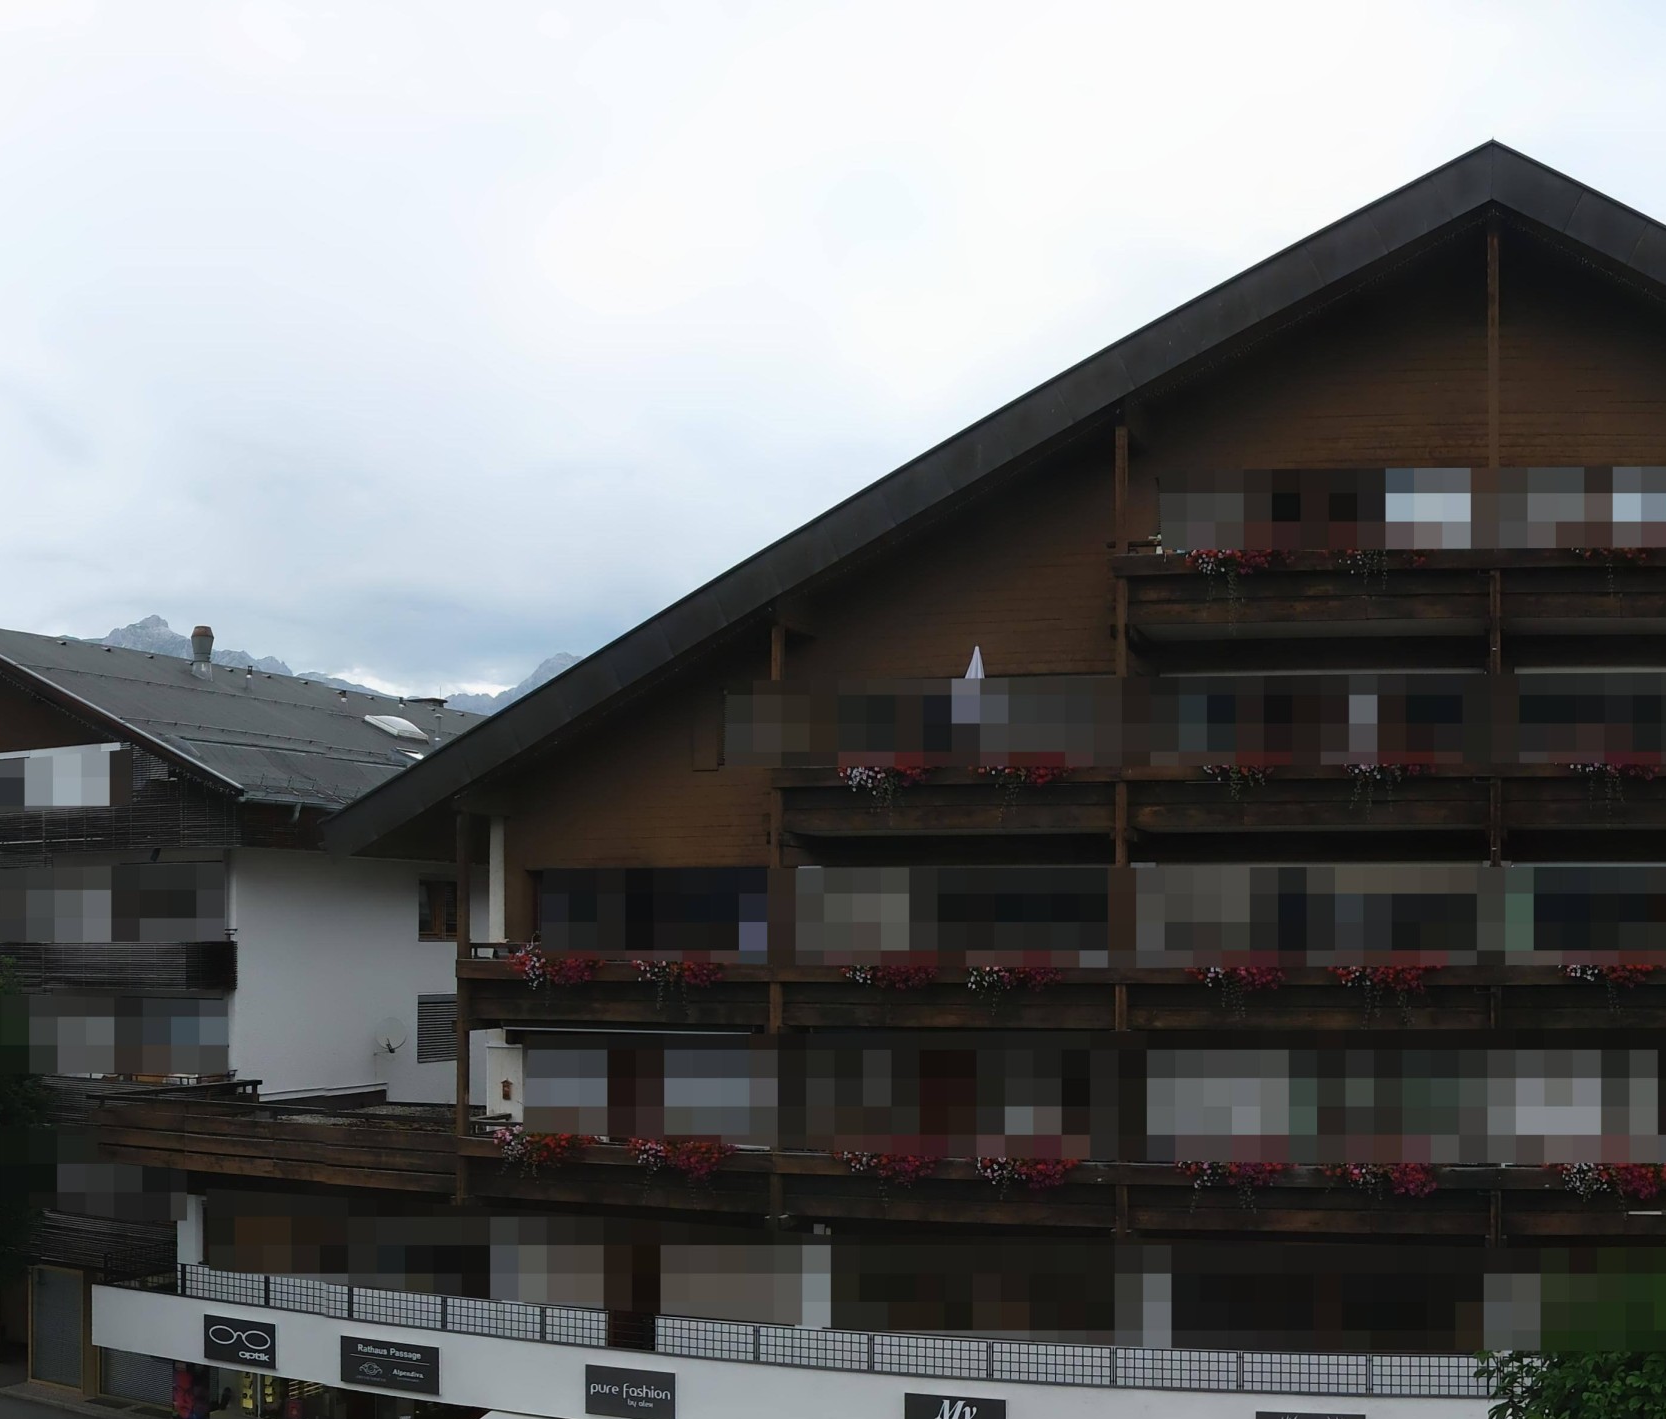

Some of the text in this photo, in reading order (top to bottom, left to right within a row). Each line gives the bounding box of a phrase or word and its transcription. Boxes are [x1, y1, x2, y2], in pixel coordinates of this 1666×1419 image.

[239, 1351, 269, 1362] optik
[358, 1343, 421, 1360] Rathaus Passage
[590, 1383, 671, 1400] pure fashion
[627, 1399, 637, 1407] by
